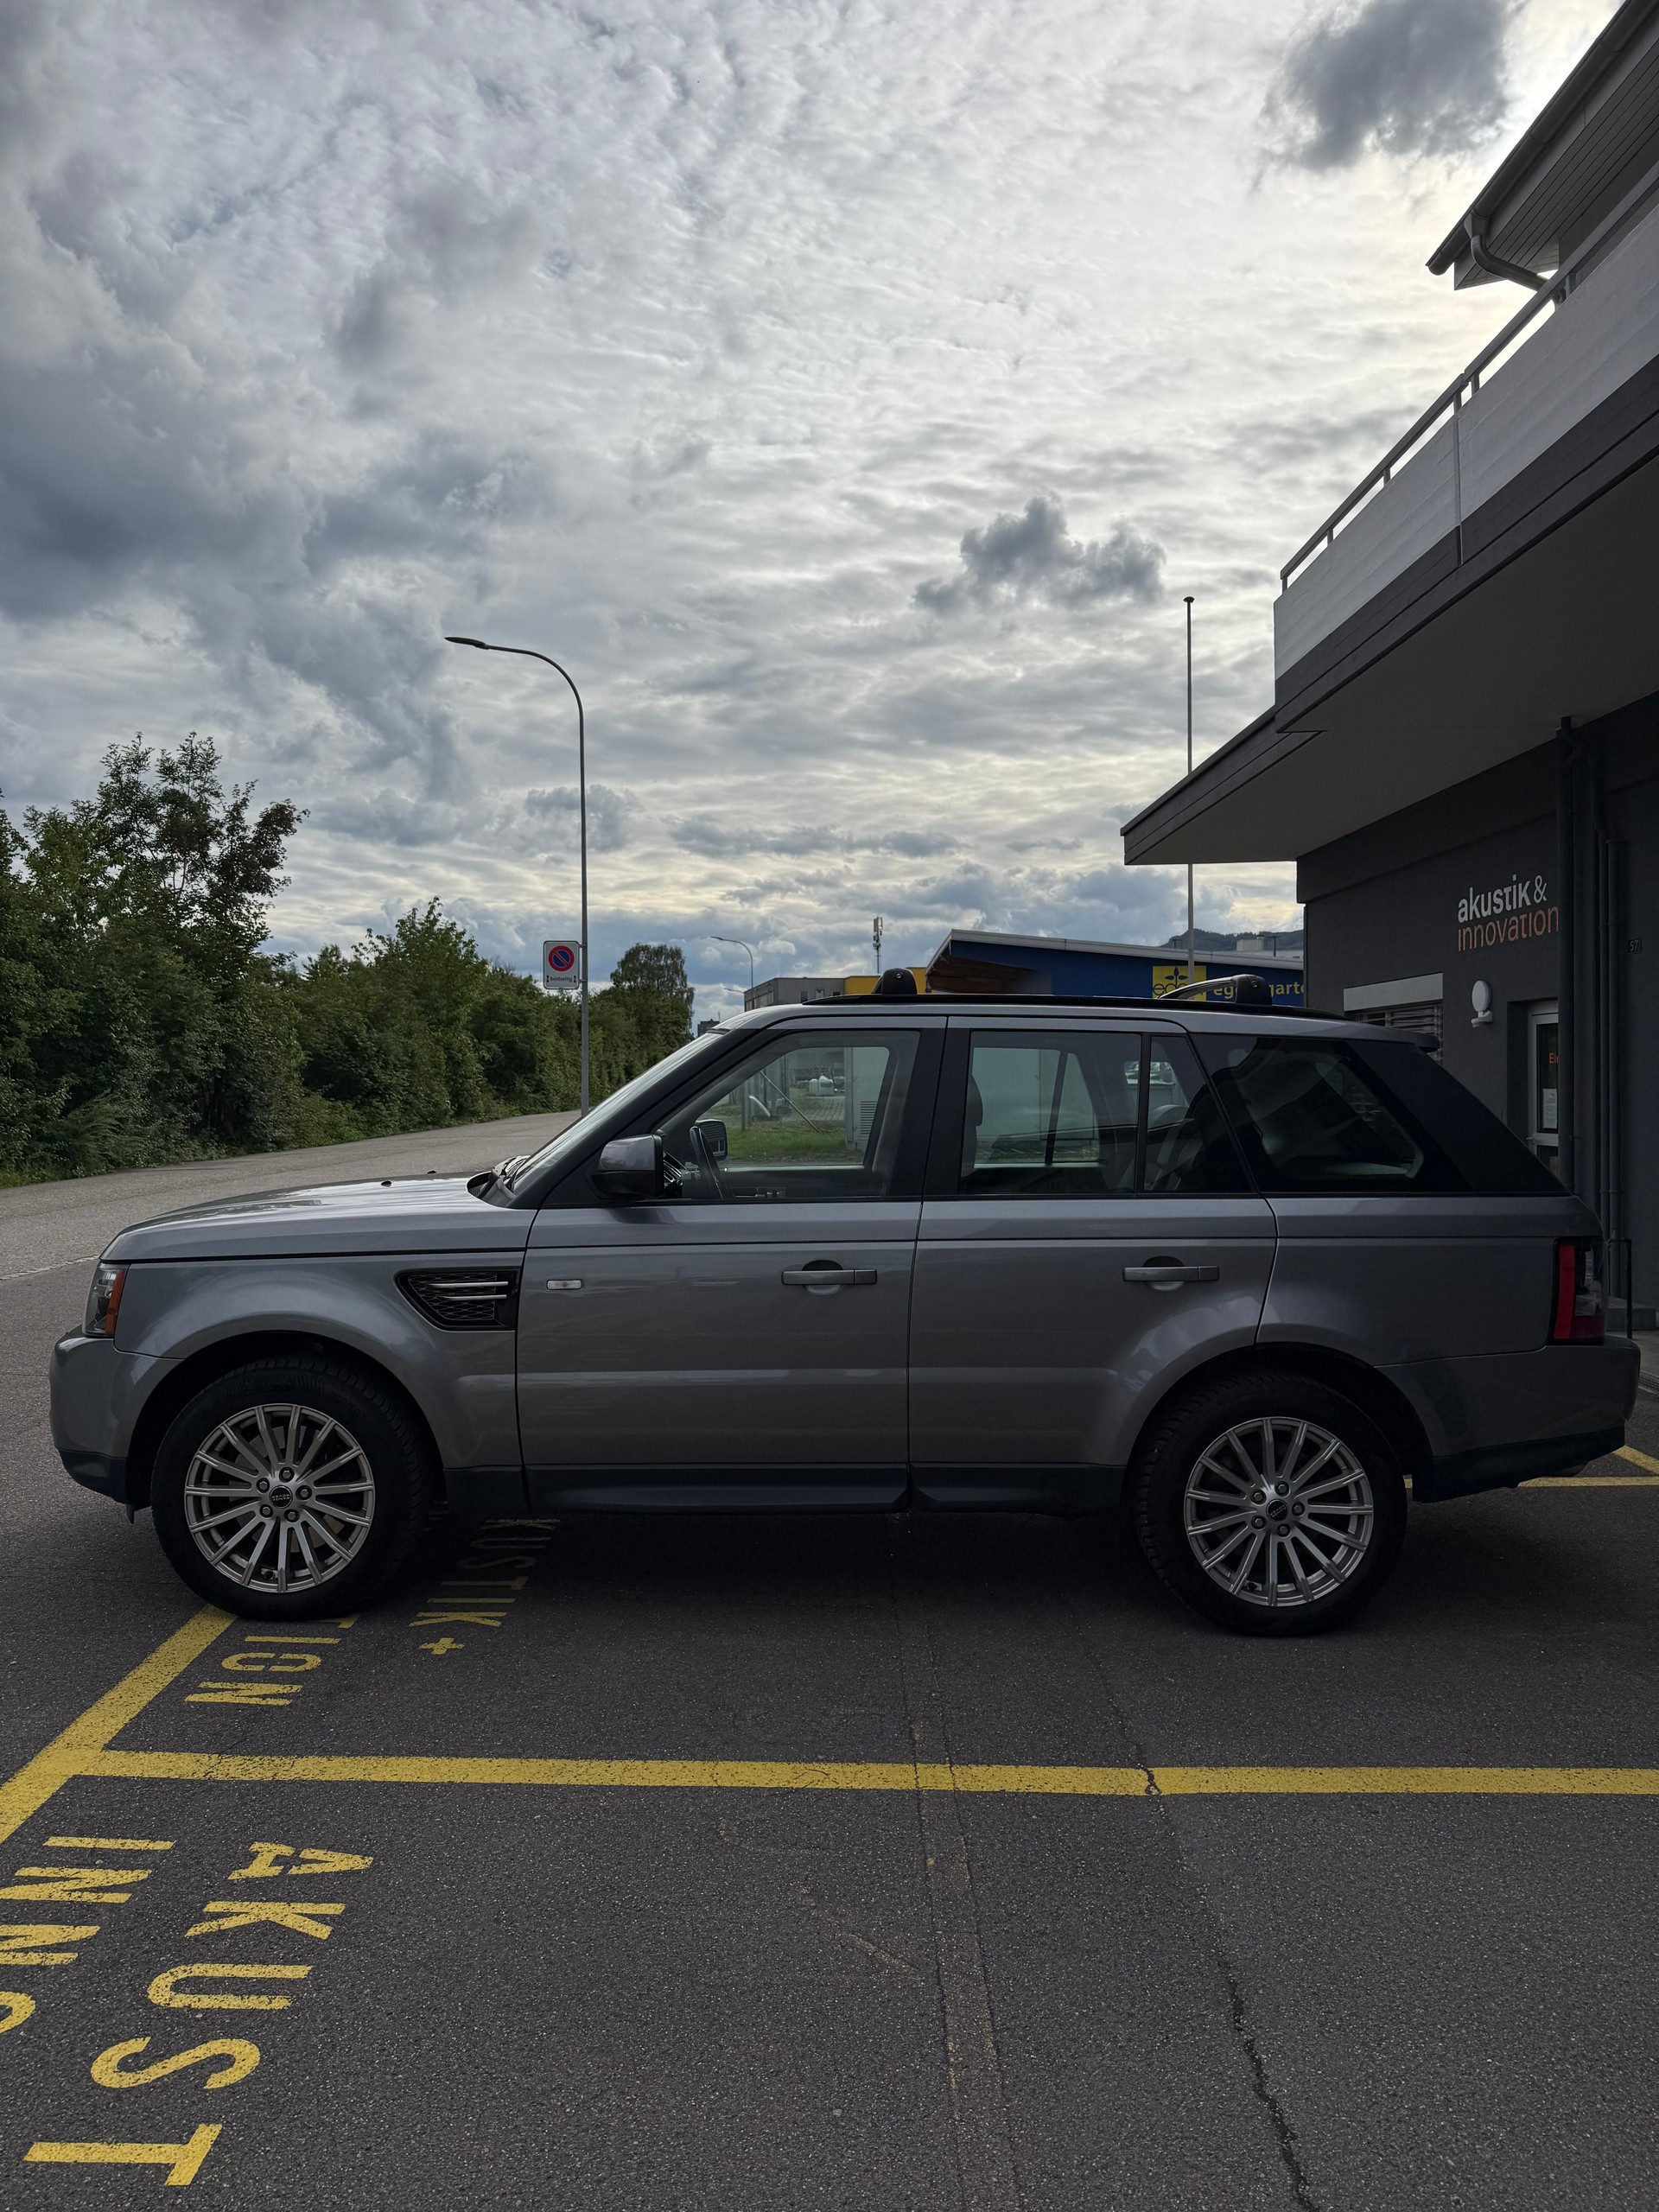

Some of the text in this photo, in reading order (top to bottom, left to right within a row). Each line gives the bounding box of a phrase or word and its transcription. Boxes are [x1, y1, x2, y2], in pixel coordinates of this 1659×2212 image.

[1458, 874, 1531, 923] akustik
[1458, 906, 1559, 951] innovation
[1629, 939, 1639, 952] 57
[409, 1518, 560, 1628] KUSTIK
[0, 1836, 175, 2034] INN
